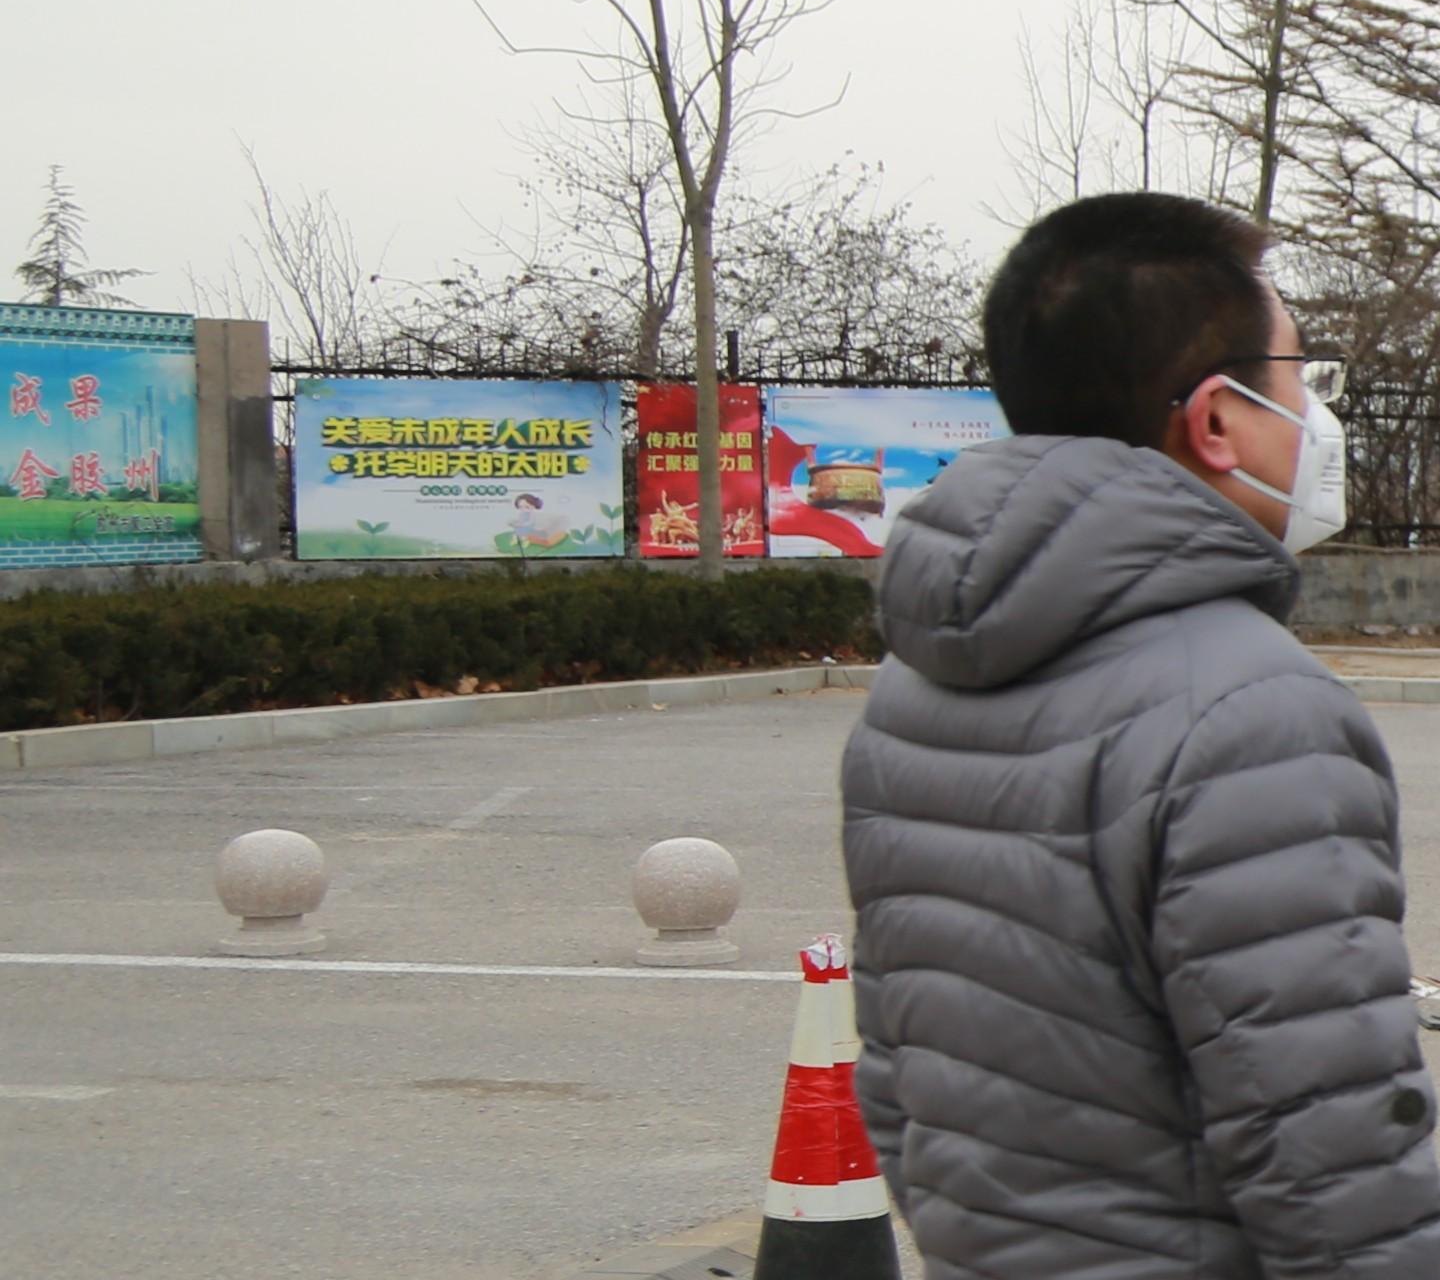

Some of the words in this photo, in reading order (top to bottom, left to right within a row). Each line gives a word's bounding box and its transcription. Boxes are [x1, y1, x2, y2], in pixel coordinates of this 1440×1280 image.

[322, 417, 593, 448] 关爱未成年人成长
[646, 432, 753, 449] 传承红基因
[9, 448, 161, 502] 金胶州
[354, 450, 569, 478] 托举明天的太阳
[647, 455, 754, 471] 汇聚强力量
